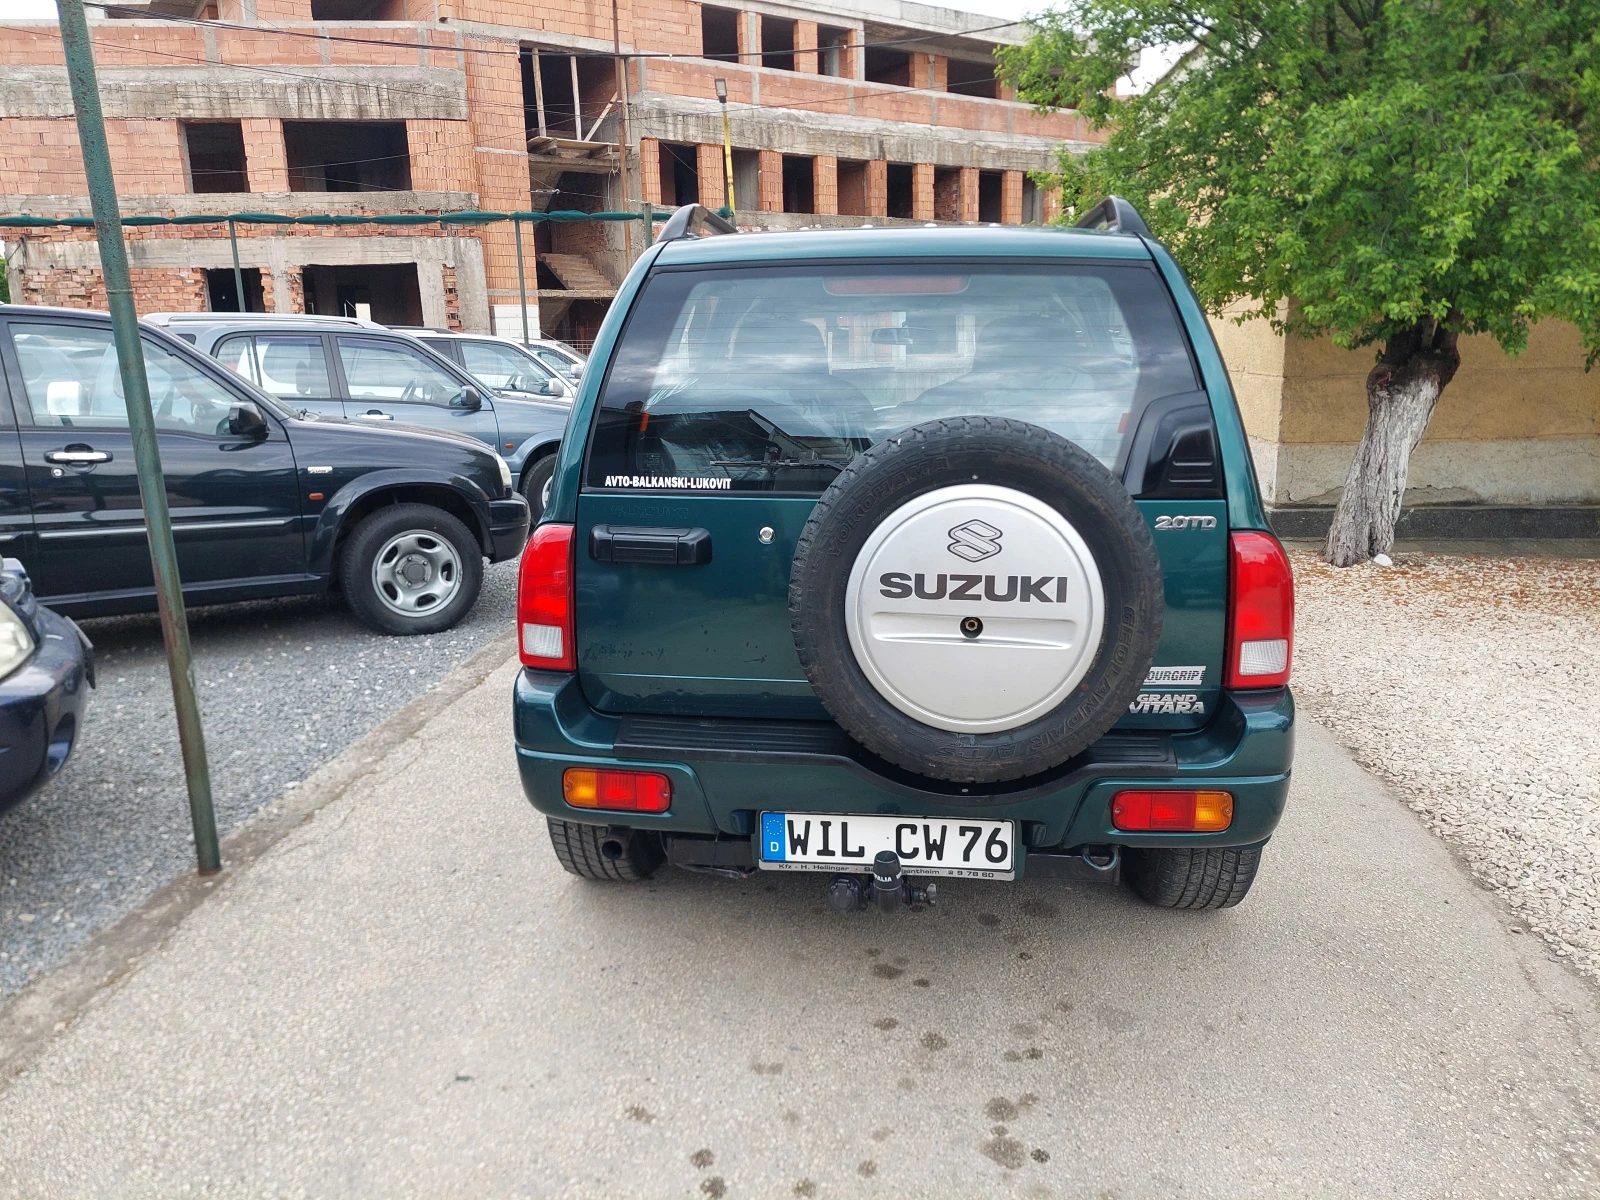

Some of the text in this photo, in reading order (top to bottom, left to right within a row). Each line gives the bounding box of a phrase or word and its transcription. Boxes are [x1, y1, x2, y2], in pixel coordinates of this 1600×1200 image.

[605, 475, 732, 490] AVTO-BALKANSKI-LUKOVIT
[826, 456, 950, 557] YOKOHAMA
[879, 572, 1068, 603] SUZUKI
[1029, 604, 1137, 751] GEOLANDAR
[1147, 670, 1200, 681] OURGRIP
[1136, 693, 1198, 703] GRAND
[1128, 701, 1205, 714] VITARA
[770, 841, 779, 852] D
[787, 819, 1009, 864] WIL CW 76
